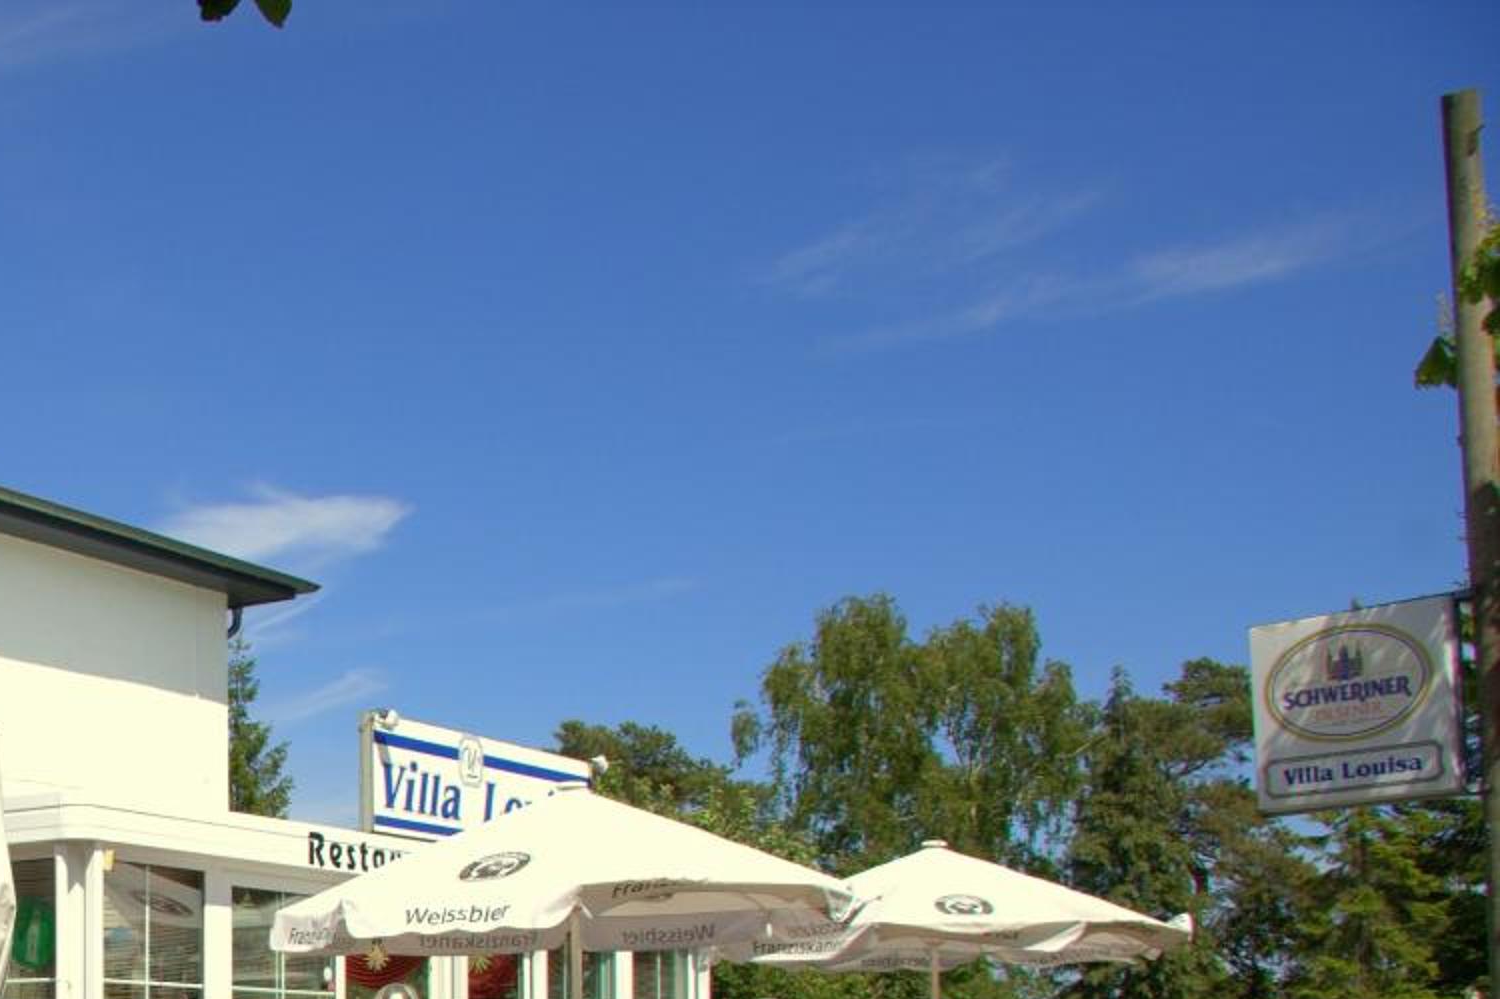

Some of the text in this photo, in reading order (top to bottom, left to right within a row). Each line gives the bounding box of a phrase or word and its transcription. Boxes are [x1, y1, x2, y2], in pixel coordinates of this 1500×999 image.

[1283, 675, 1412, 711] SCHWERINER
[1284, 756, 1423, 786] Villa Louisa
[382, 760, 462, 821] Villa
[404, 902, 512, 927] Weissbier
